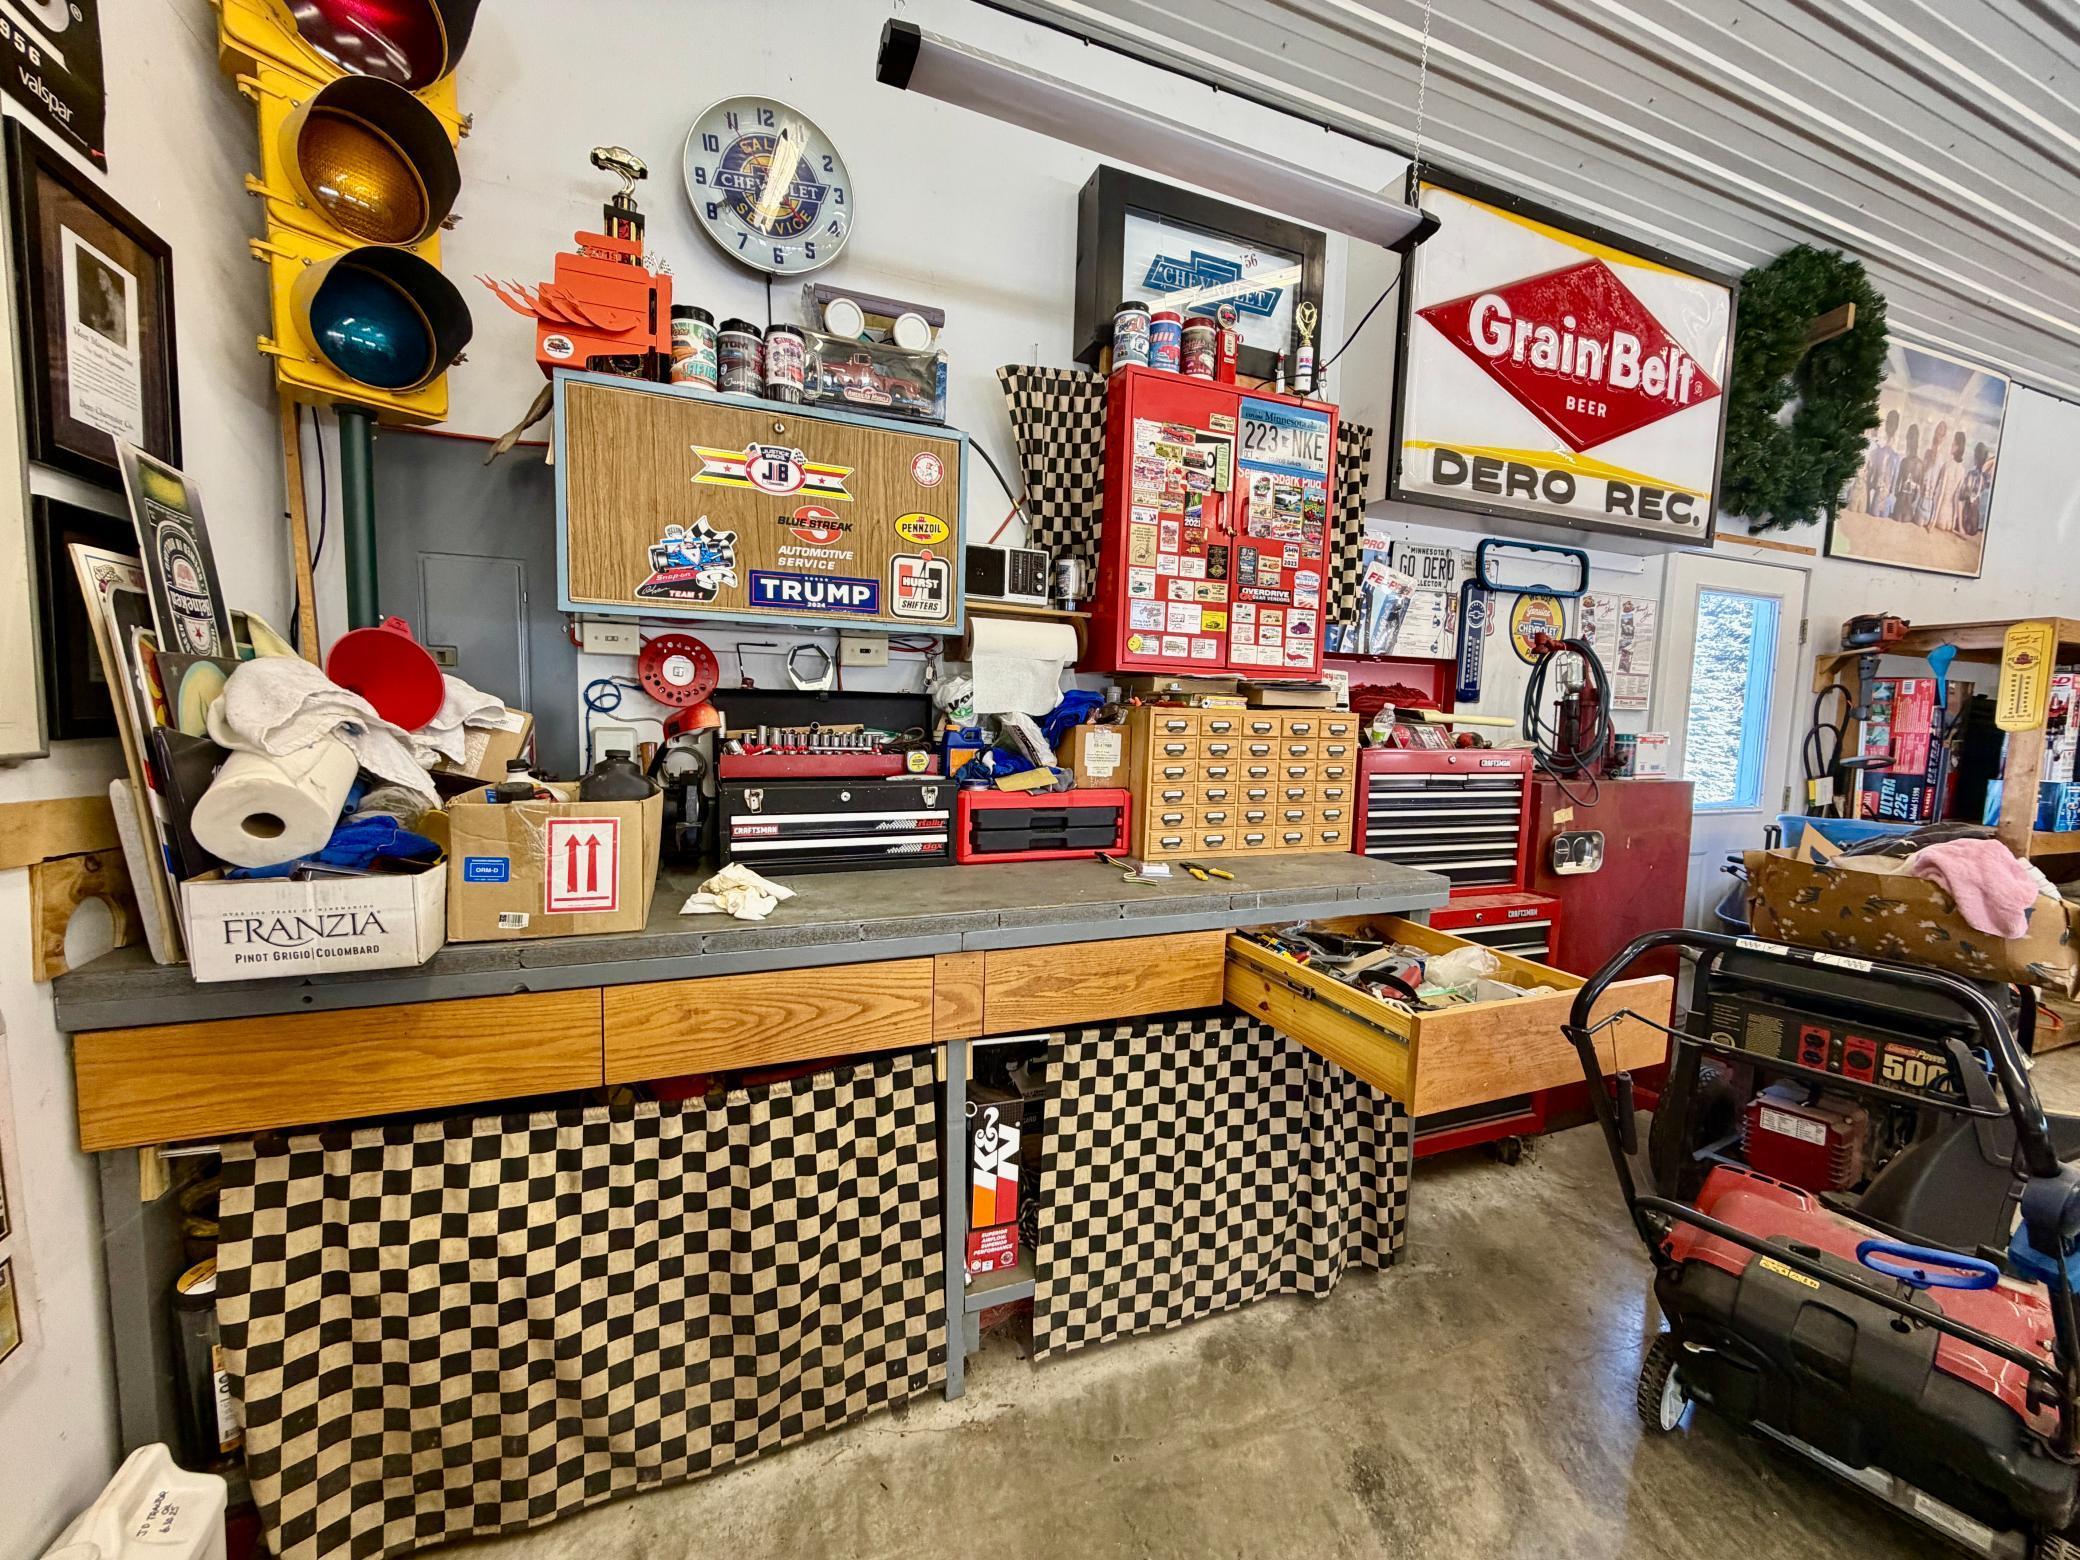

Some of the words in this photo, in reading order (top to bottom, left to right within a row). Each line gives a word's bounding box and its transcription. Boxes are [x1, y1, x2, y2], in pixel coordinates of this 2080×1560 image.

[18, 65, 73, 122] valspar
[725, 112, 739, 131] 11
[757, 107, 775, 128] 12
[702, 133, 720, 153] 10
[822, 155, 833, 173] 2
[695, 166, 707, 185] 9
[834, 187, 845, 205] 3
[706, 202, 718, 220] 8
[737, 232, 748, 250] 7
[773, 247, 784, 265] 6
[805, 241, 816, 260] 5
[1469, 293, 1602, 381] Grain
[1608, 330, 1694, 404] Belt
[1566, 395, 1607, 418] BEER
[1244, 420, 1278, 453] 223
[1292, 430, 1325, 461] NKE
[762, 447, 790, 457] JUSTICE
[1432, 447, 1577, 505] DERO
[1605, 479, 1700, 527] REC.
[778, 515, 807, 527] BLUE
[808, 517, 854, 532] STREAK
[902, 523, 942, 533] PENNZOIL
[1184, 519, 1200, 528] 2021
[778, 545, 854, 560] AUTOMOTIVE
[1410, 546, 1445, 556] MINNESOTA
[778, 557, 835, 570] SERVICE
[1400, 554, 1416, 577] GO
[1423, 555, 1455, 581] DERO
[655, 571, 691, 581] Snap-on
[902, 576, 940, 590] HURST
[669, 590, 695, 599] TEAM
[760, 578, 871, 605] TRUMP
[1241, 588, 1290, 598] OVERDRIVE
[171, 591, 213, 617] Heineken
[902, 600, 939, 611] SHIFTERS
[1526, 605, 1552, 617] Genuine
[1518, 624, 1557, 637] CHEVROLET
[1480, 759, 1511, 767] CRAFTSMAN
[1879, 778, 1897, 816] ULTRA
[1893, 793, 1909, 819] 225
[1909, 802, 1918, 821] Model
[733, 825, 778, 835] CRAFTSMAN
[917, 819, 945, 829] Rally
[318, 904, 374, 912] WINEMAKING
[1508, 908, 1538, 918] CRAFTSMAN
[223, 911, 389, 948] FRANZIA
[235, 953, 268, 964] PINOT
[981, 1228, 1008, 1239] SUPERIOR
[973, 1243, 1014, 1256] PERFORMANCE
[980, 1239, 1008, 1249] SUPERIOR
